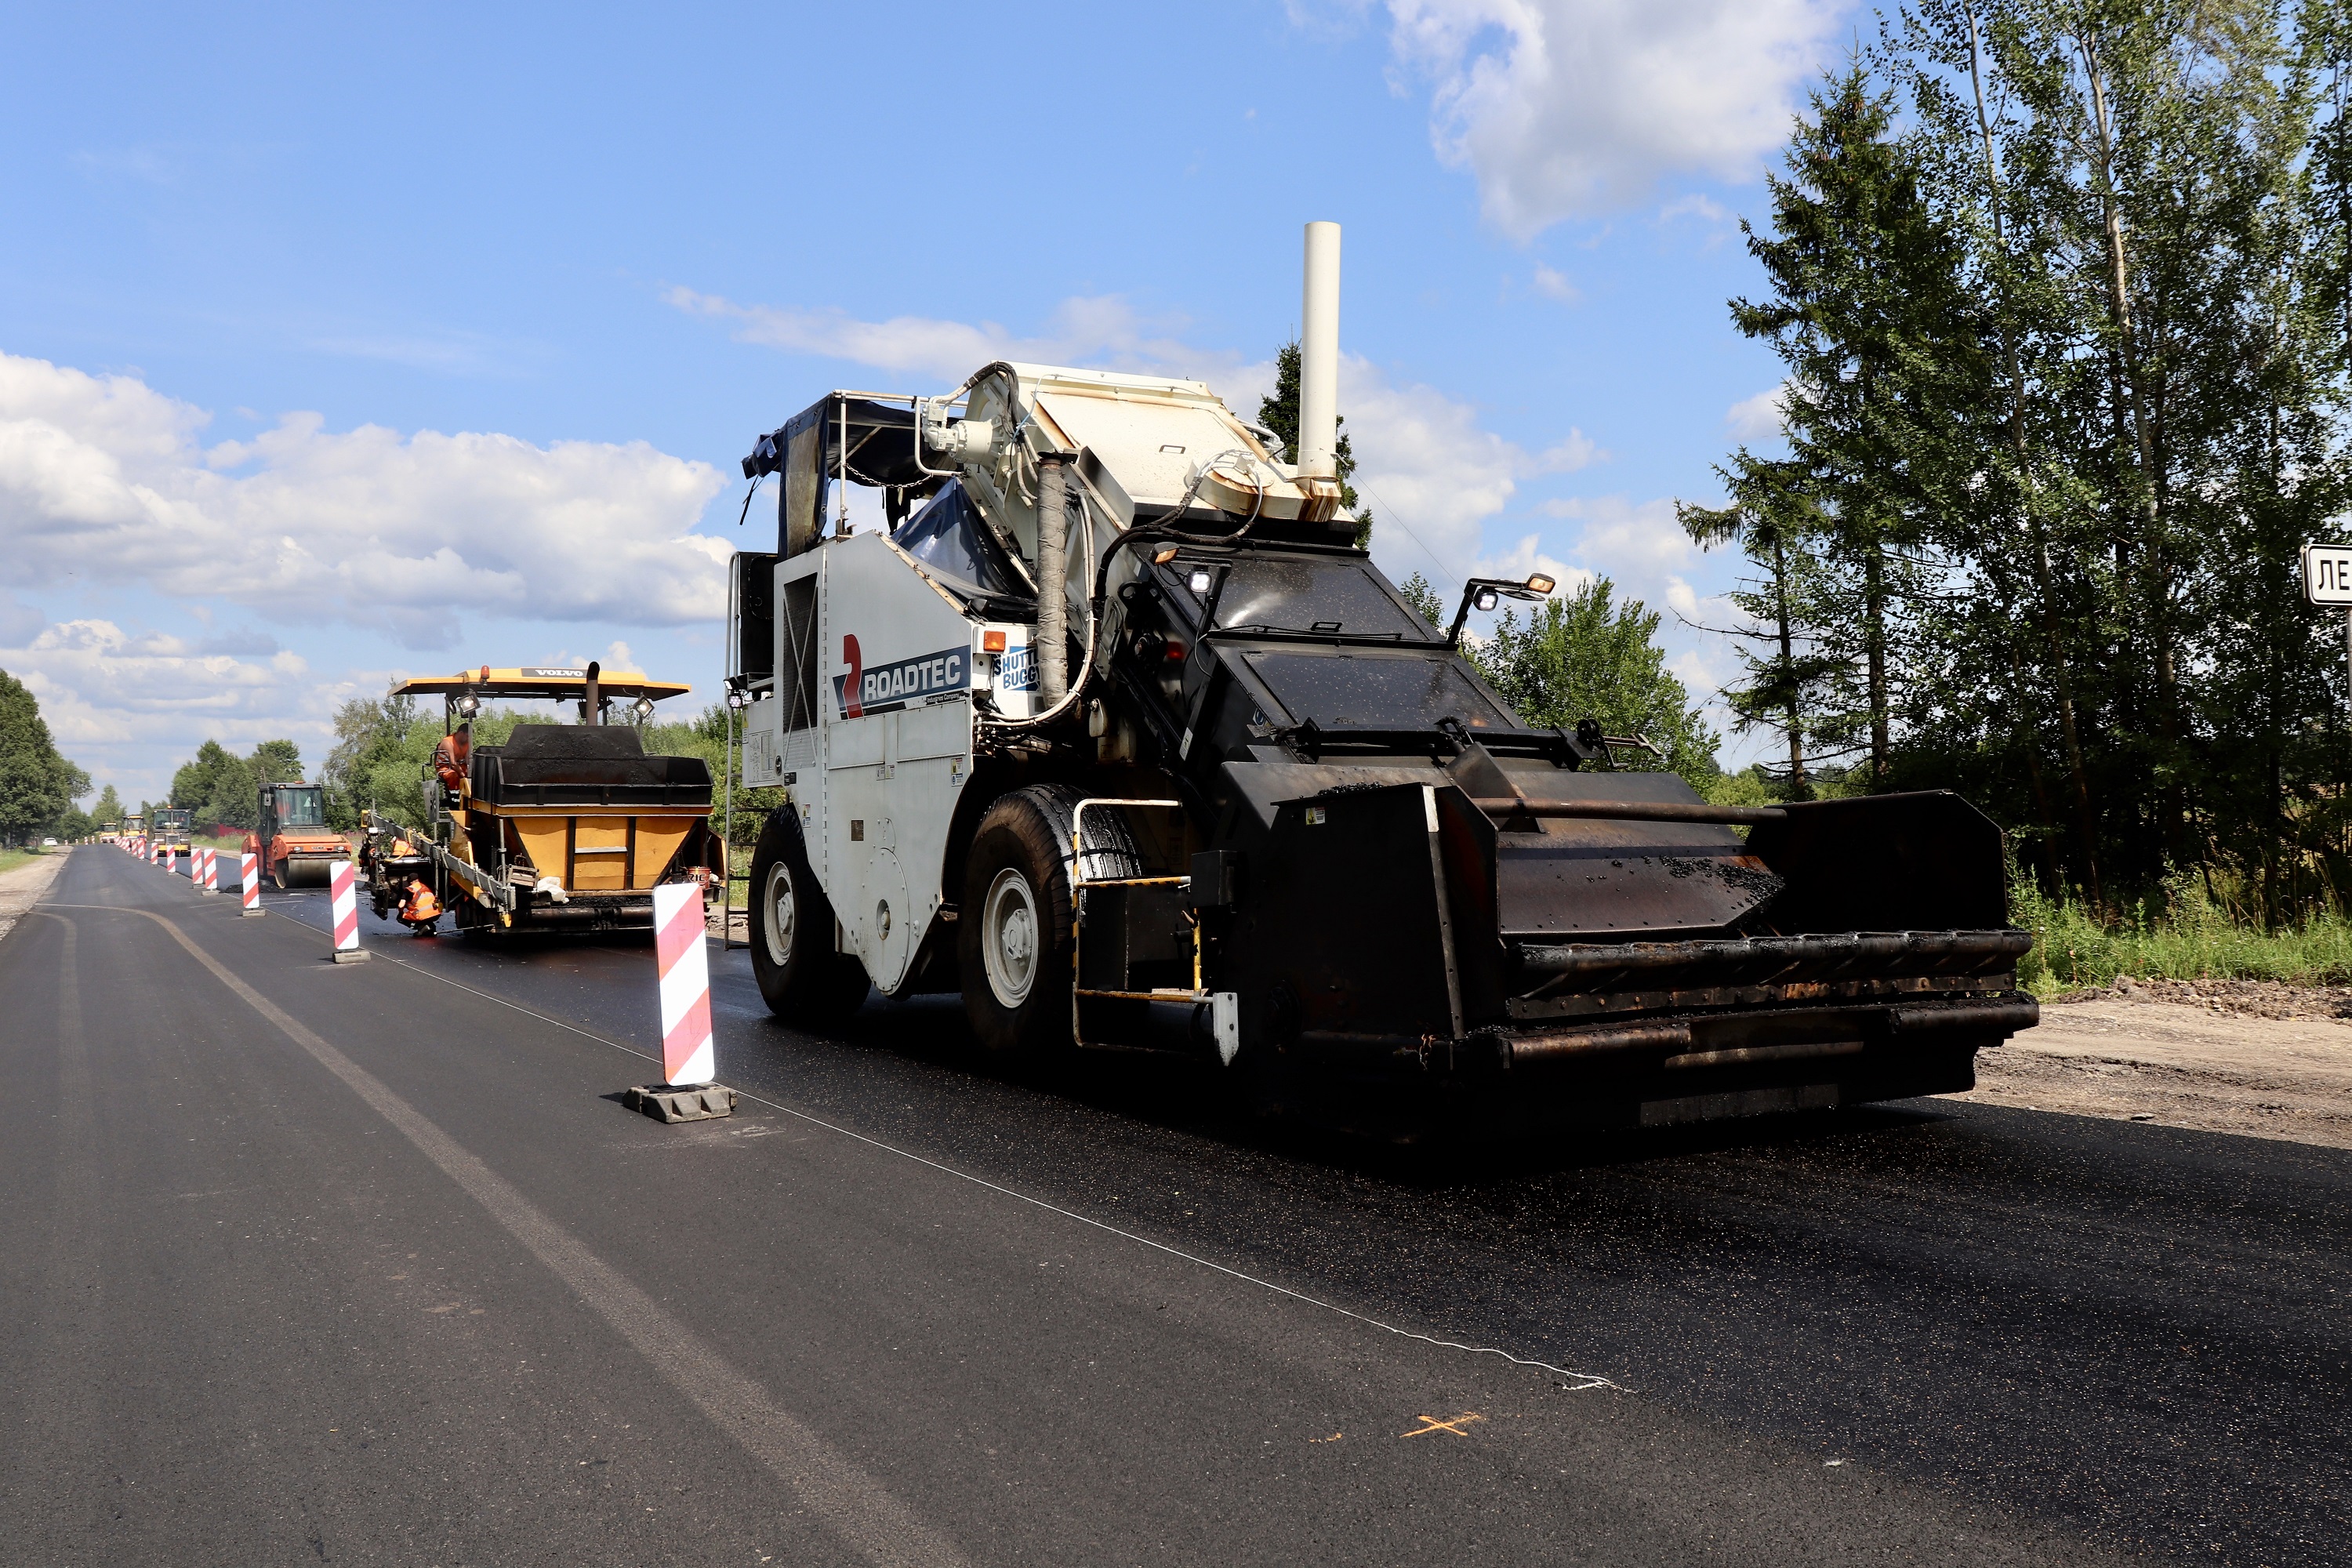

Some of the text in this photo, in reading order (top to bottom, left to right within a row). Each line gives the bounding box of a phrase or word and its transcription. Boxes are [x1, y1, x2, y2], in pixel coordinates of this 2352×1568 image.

[2318, 560, 2350, 590] ЛЕ
[993, 648, 1040, 676] SHUTTL
[864, 655, 961, 702] ROADTEC
